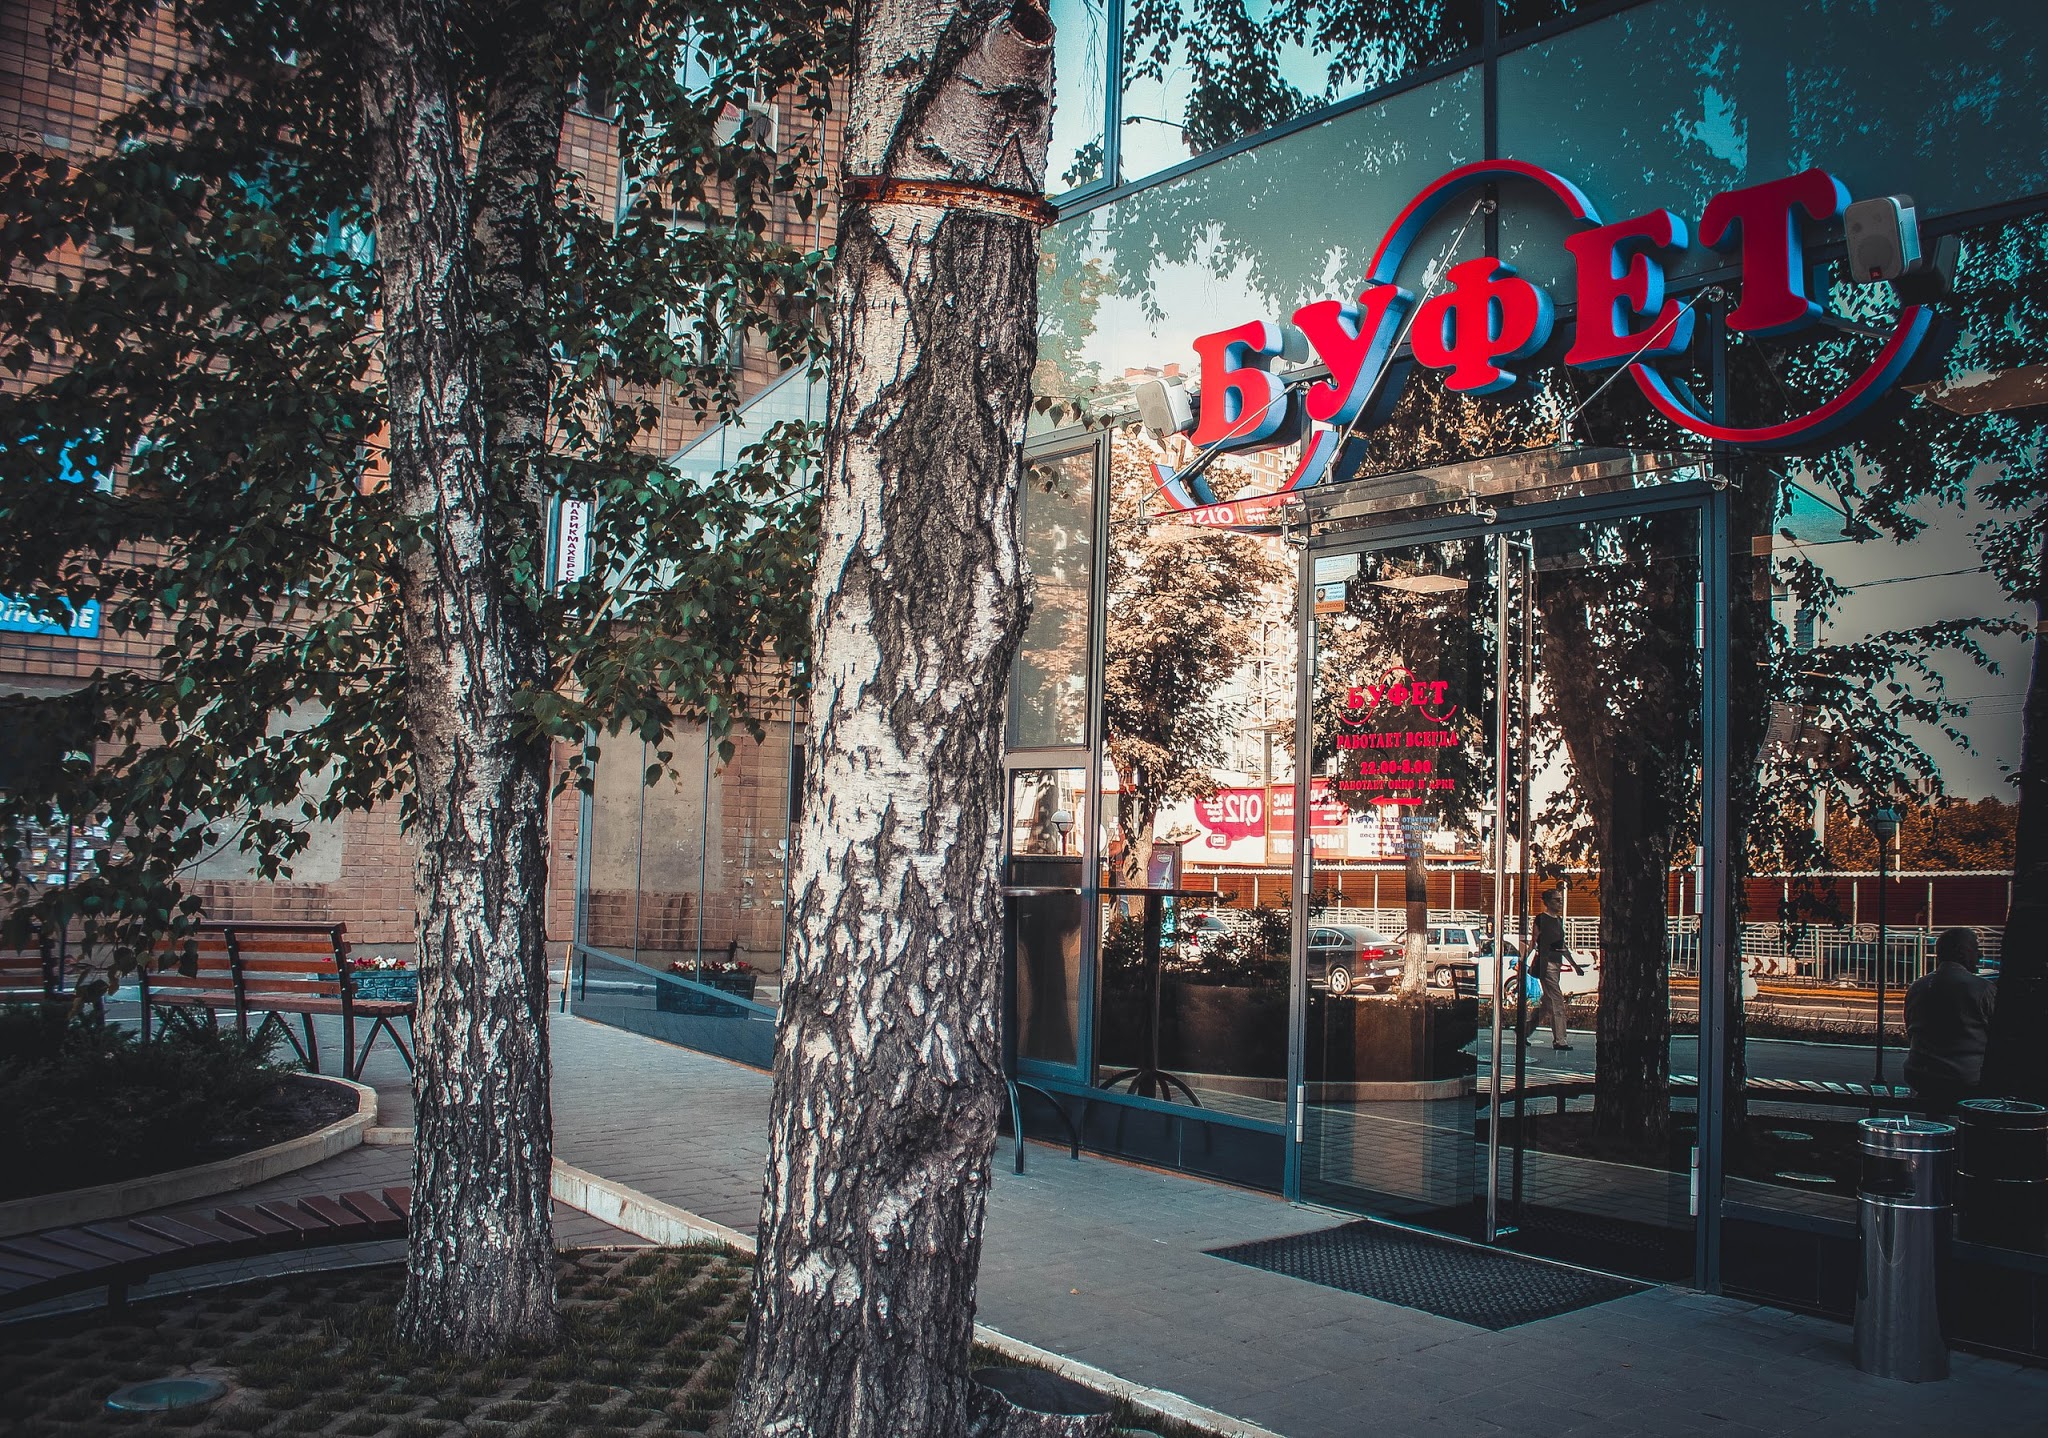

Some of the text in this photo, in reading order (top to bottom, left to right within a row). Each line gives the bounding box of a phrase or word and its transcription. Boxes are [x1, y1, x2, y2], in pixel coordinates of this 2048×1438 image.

[1191, 168, 1849, 452] БУФЕТ
[1347, 681, 1449, 709] БУФЕТ
[1336, 730, 1458, 750] РАБОТАЕТ ВСЕГДА
[1360, 759, 1432, 775] 22.00-8.00
[1338, 779, 1455, 791] РАБОТАЕТ ОКНО В АРКЕ
